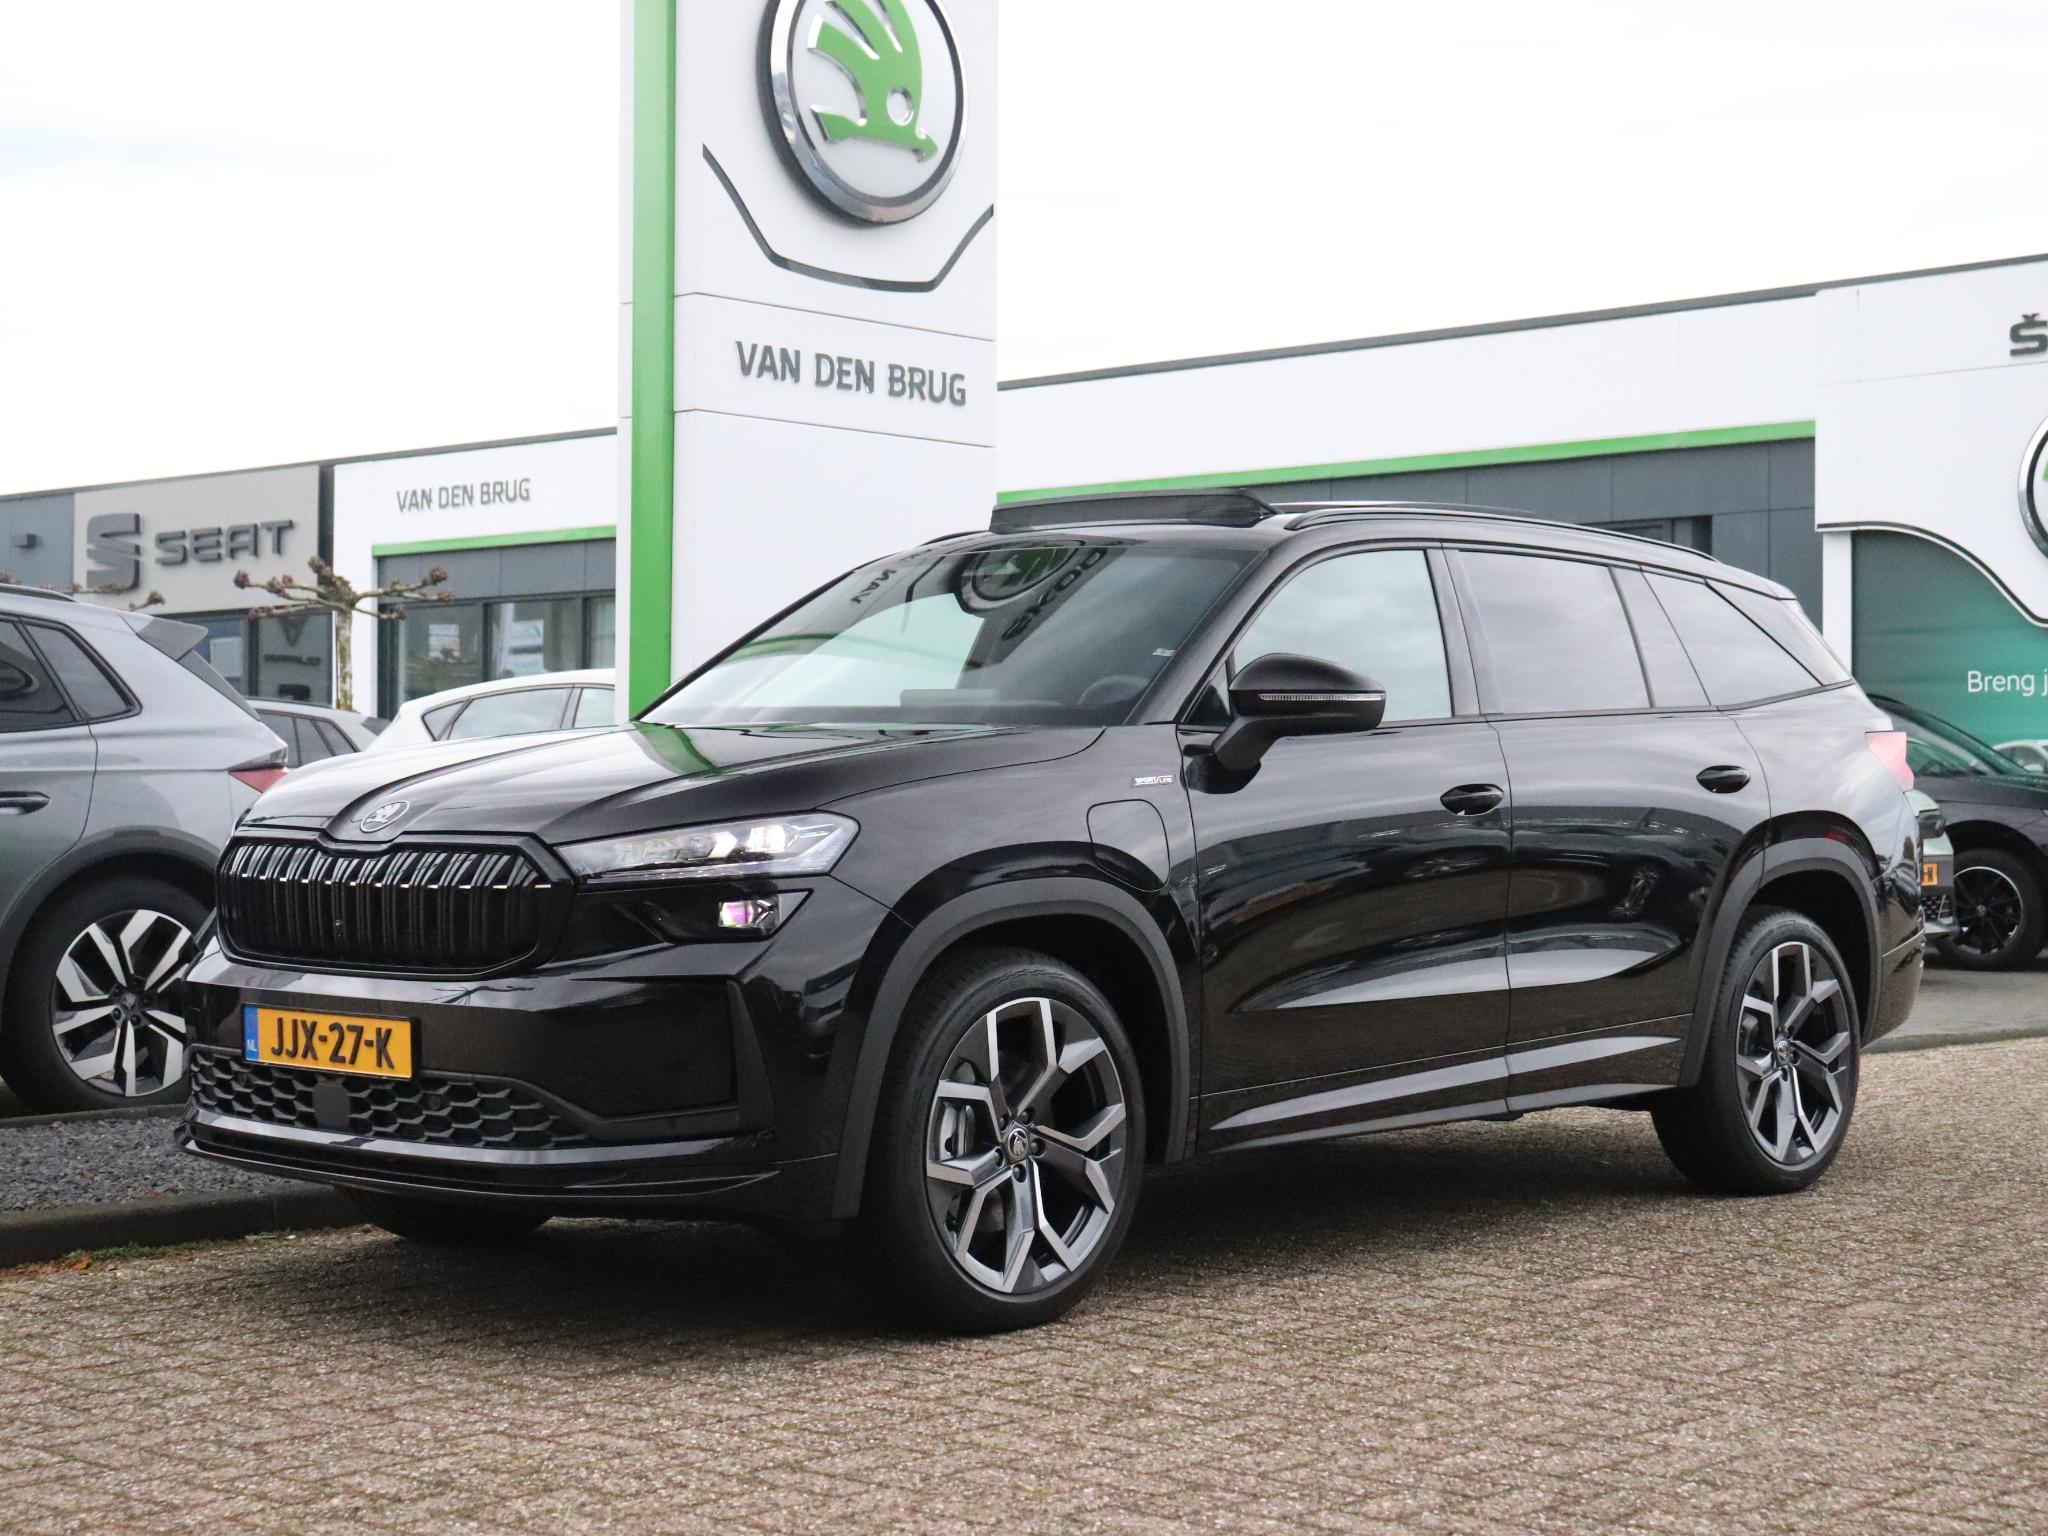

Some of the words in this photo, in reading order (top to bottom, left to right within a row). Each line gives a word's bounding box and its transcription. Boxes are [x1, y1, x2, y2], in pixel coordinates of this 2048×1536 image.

[735, 341, 801, 383] VAN
[814, 353, 875, 394] DEN
[887, 363, 967, 407] BRUG
[397, 488, 432, 512] VAN
[438, 483, 474, 509] DEN
[480, 478, 531, 505] BRUG
[154, 519, 294, 567] SEAT
[1967, 670, 2035, 697] Breng
[246, 1039, 258, 1052] NL
[271, 1017, 395, 1070] JJX-27-K
